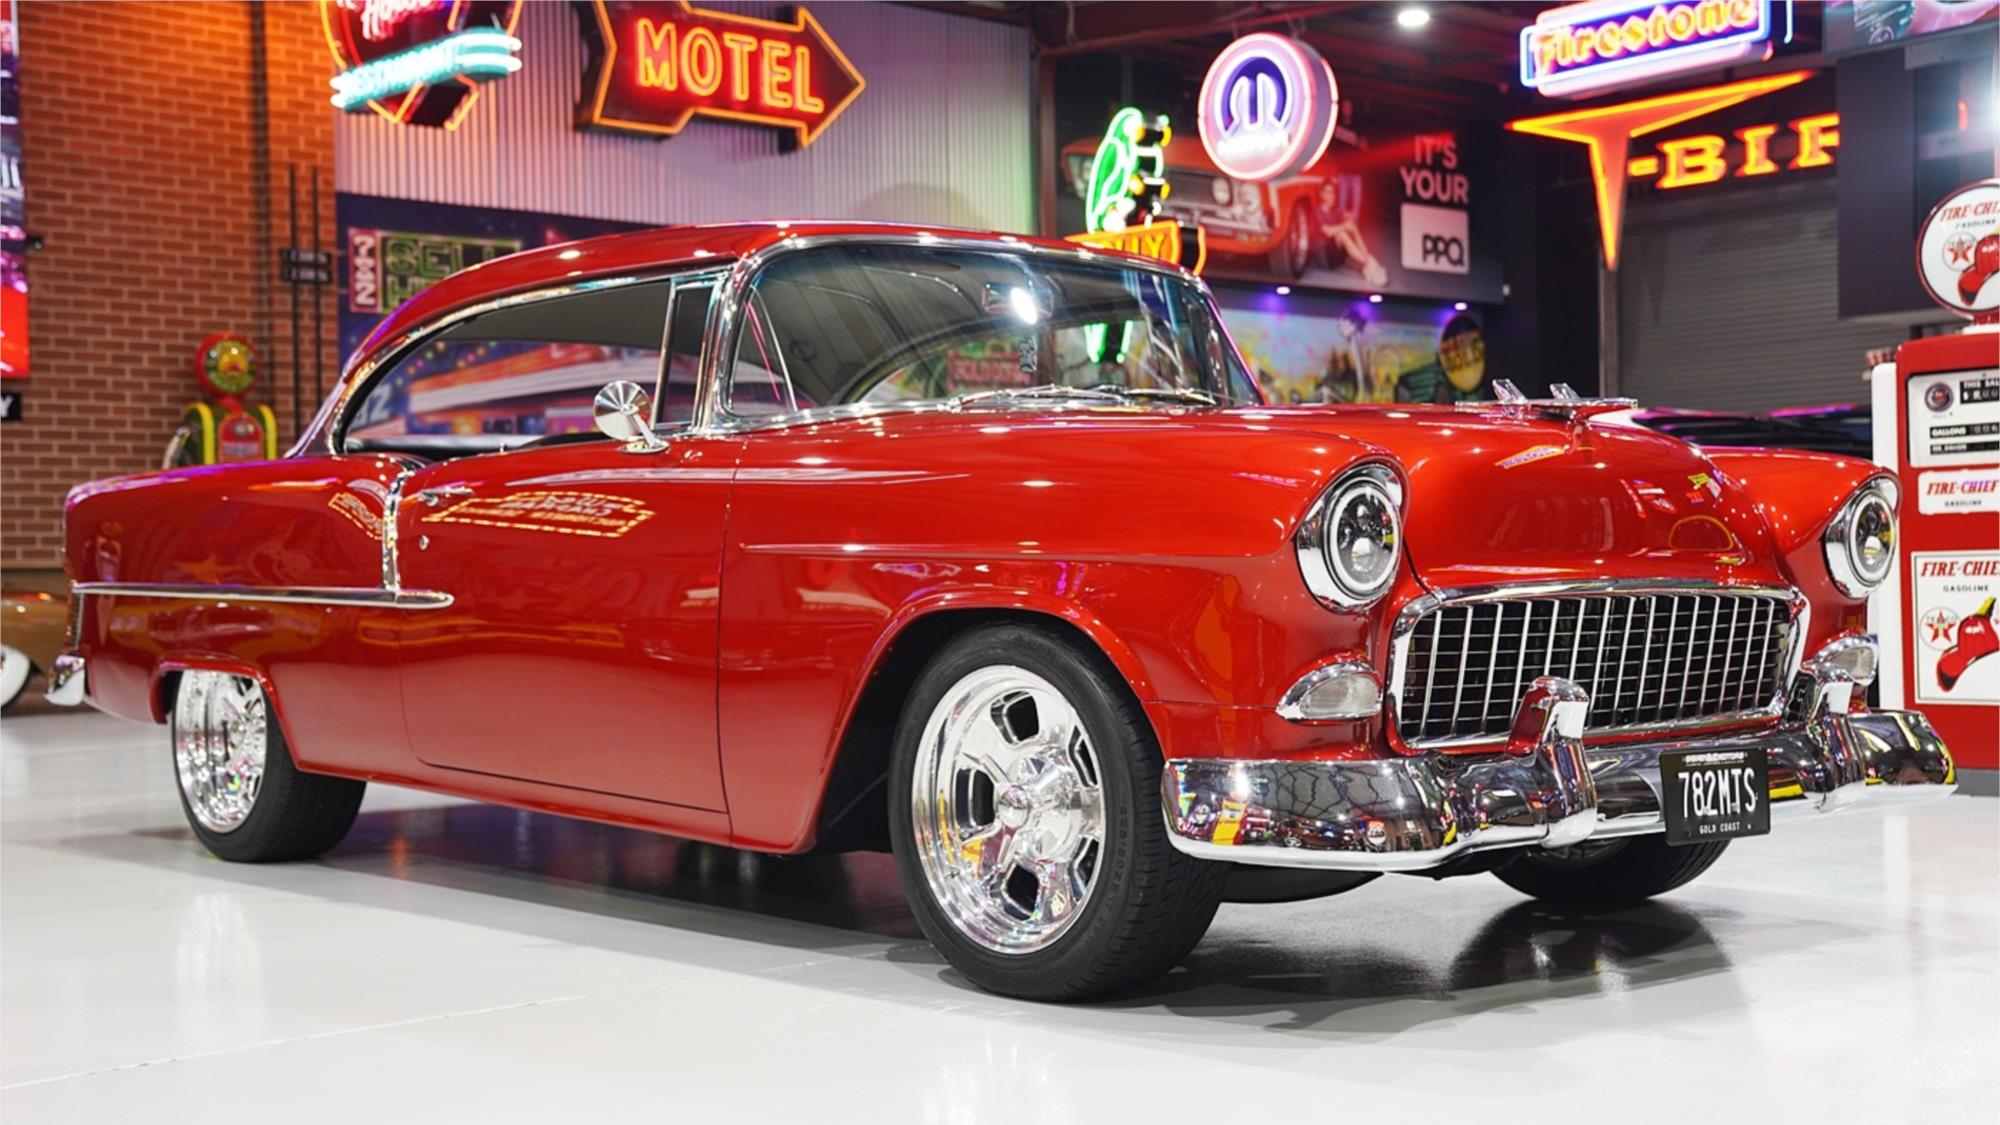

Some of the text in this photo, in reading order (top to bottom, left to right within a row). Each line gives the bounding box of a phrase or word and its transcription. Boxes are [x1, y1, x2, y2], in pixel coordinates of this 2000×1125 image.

[1532, 0, 1760, 76] Firestone
[636, 17, 825, 114] MOTEL
[1414, 133, 1458, 170] IT'S
[1400, 165, 1469, 205] YOUR
[1940, 200, 2000, 222] FIRE-CHI
[1422, 233, 1465, 268] PPQ
[1944, 499, 1982, 508] GASOLINE
[1943, 584, 1990, 593] GASOLINE
[1678, 766, 1757, 819] 782MTS
[1699, 821, 1741, 835] GOLD COAST
